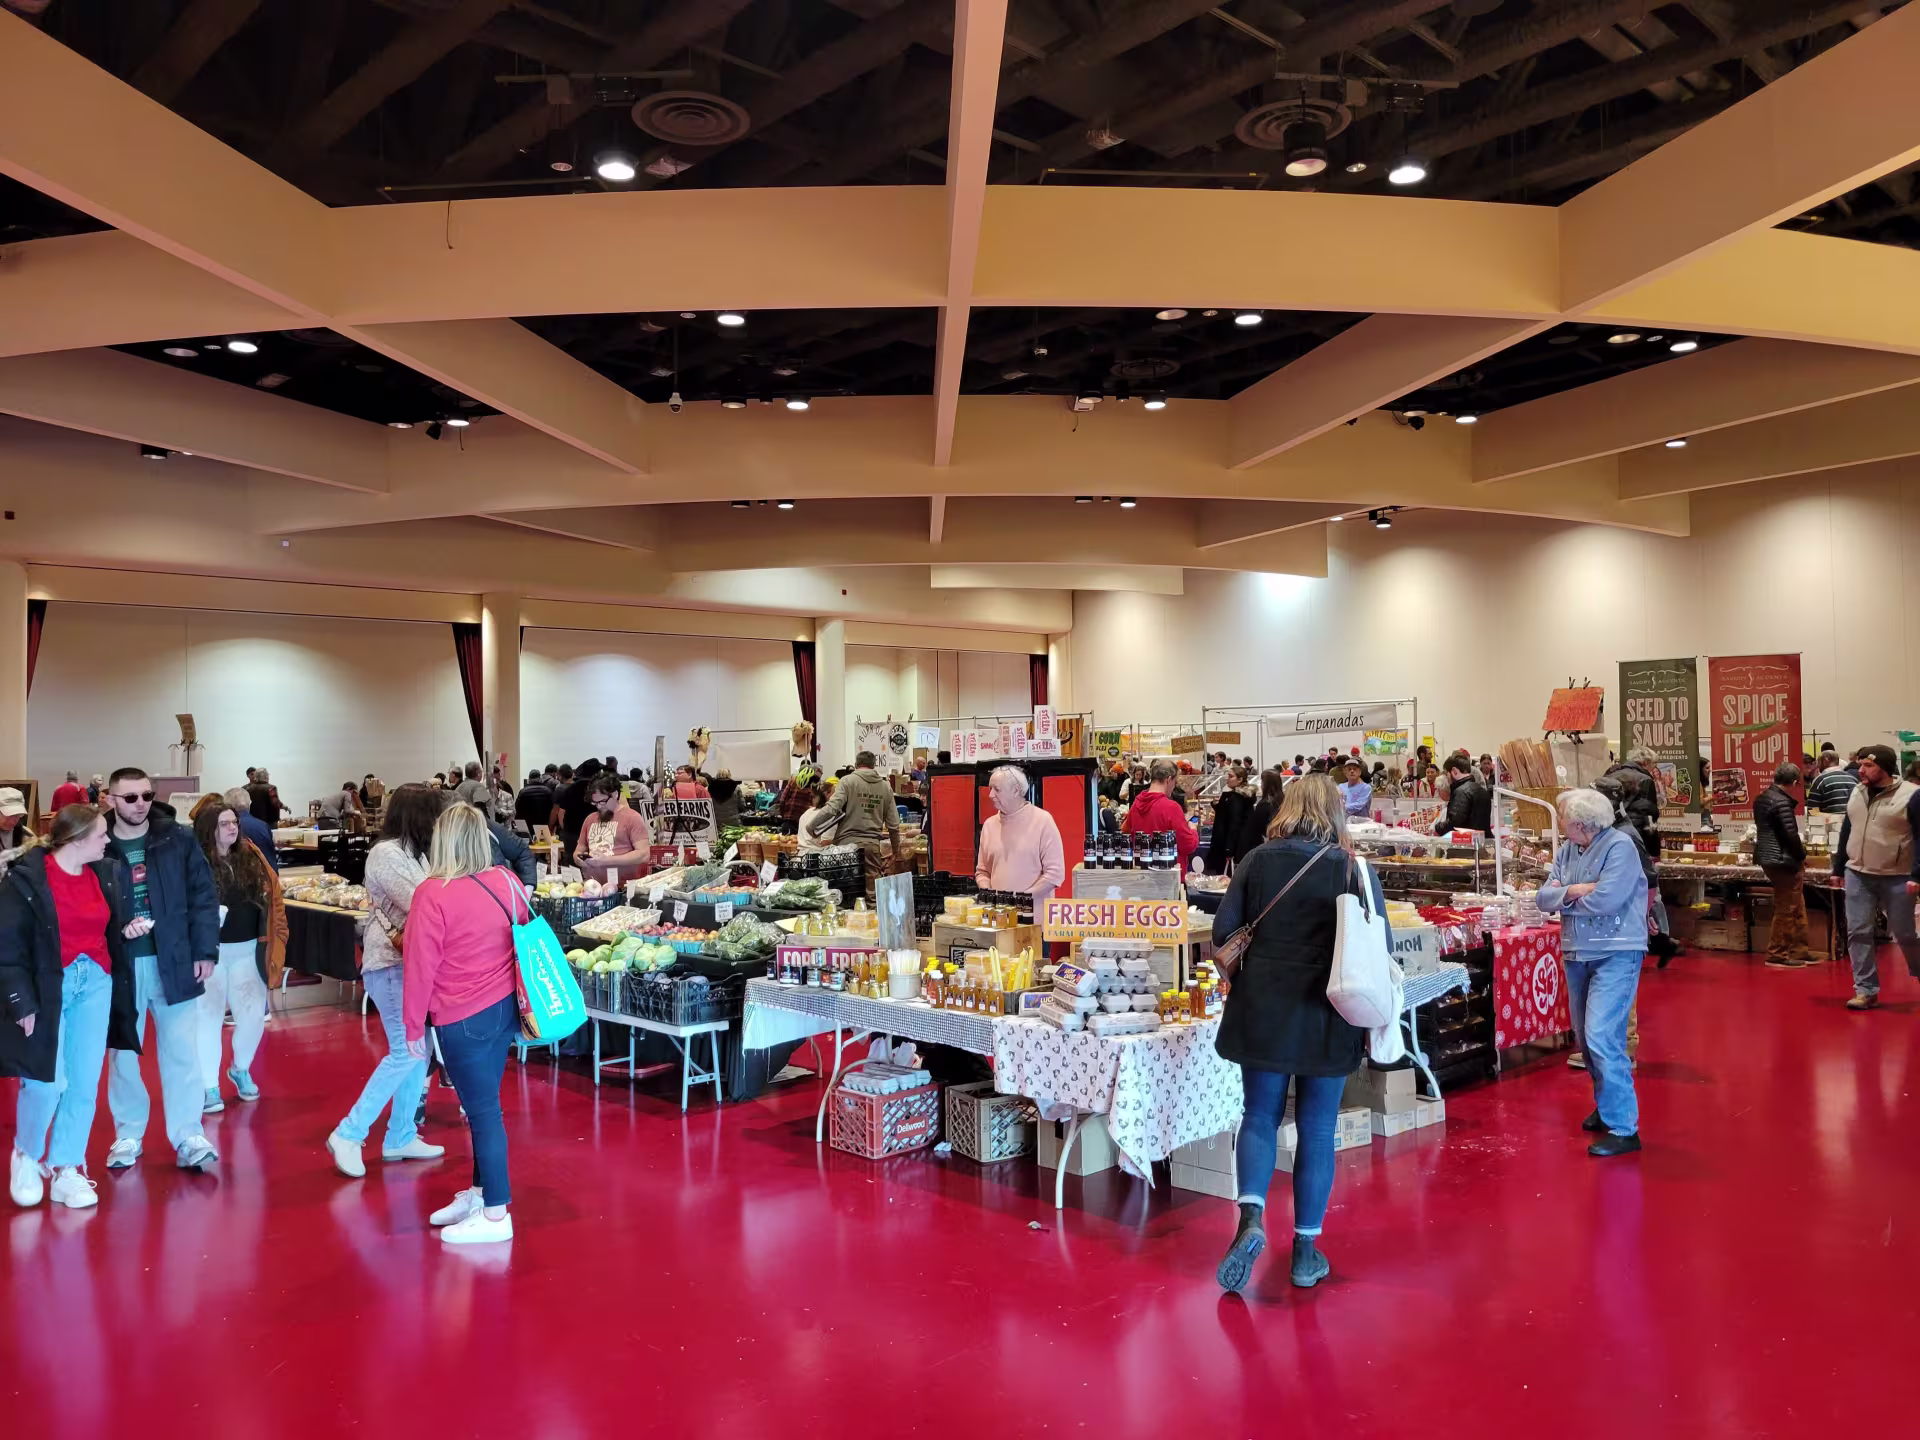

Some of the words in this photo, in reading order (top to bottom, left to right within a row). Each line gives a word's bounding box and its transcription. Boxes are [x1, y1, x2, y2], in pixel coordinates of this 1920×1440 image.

[1295, 708, 1364, 733] Empanadas
[1626, 697, 1665, 722] SEED
[1668, 696, 1689, 721] TO
[1722, 693, 1789, 725] SPICE
[1632, 722, 1684, 747] SAUCE
[1723, 733, 1745, 763] IT
[1751, 732, 1789, 763] UP!
[644, 801, 677, 820] KEER
[679, 801, 711, 819] FARMS
[1048, 903, 1116, 926] FRESH
[1124, 904, 1182, 927] EGGS
[1079, 930, 1115, 938] RAISED
[1152, 932, 1181, 940] DAILY
[897, 1118, 926, 1134] Dellwood
